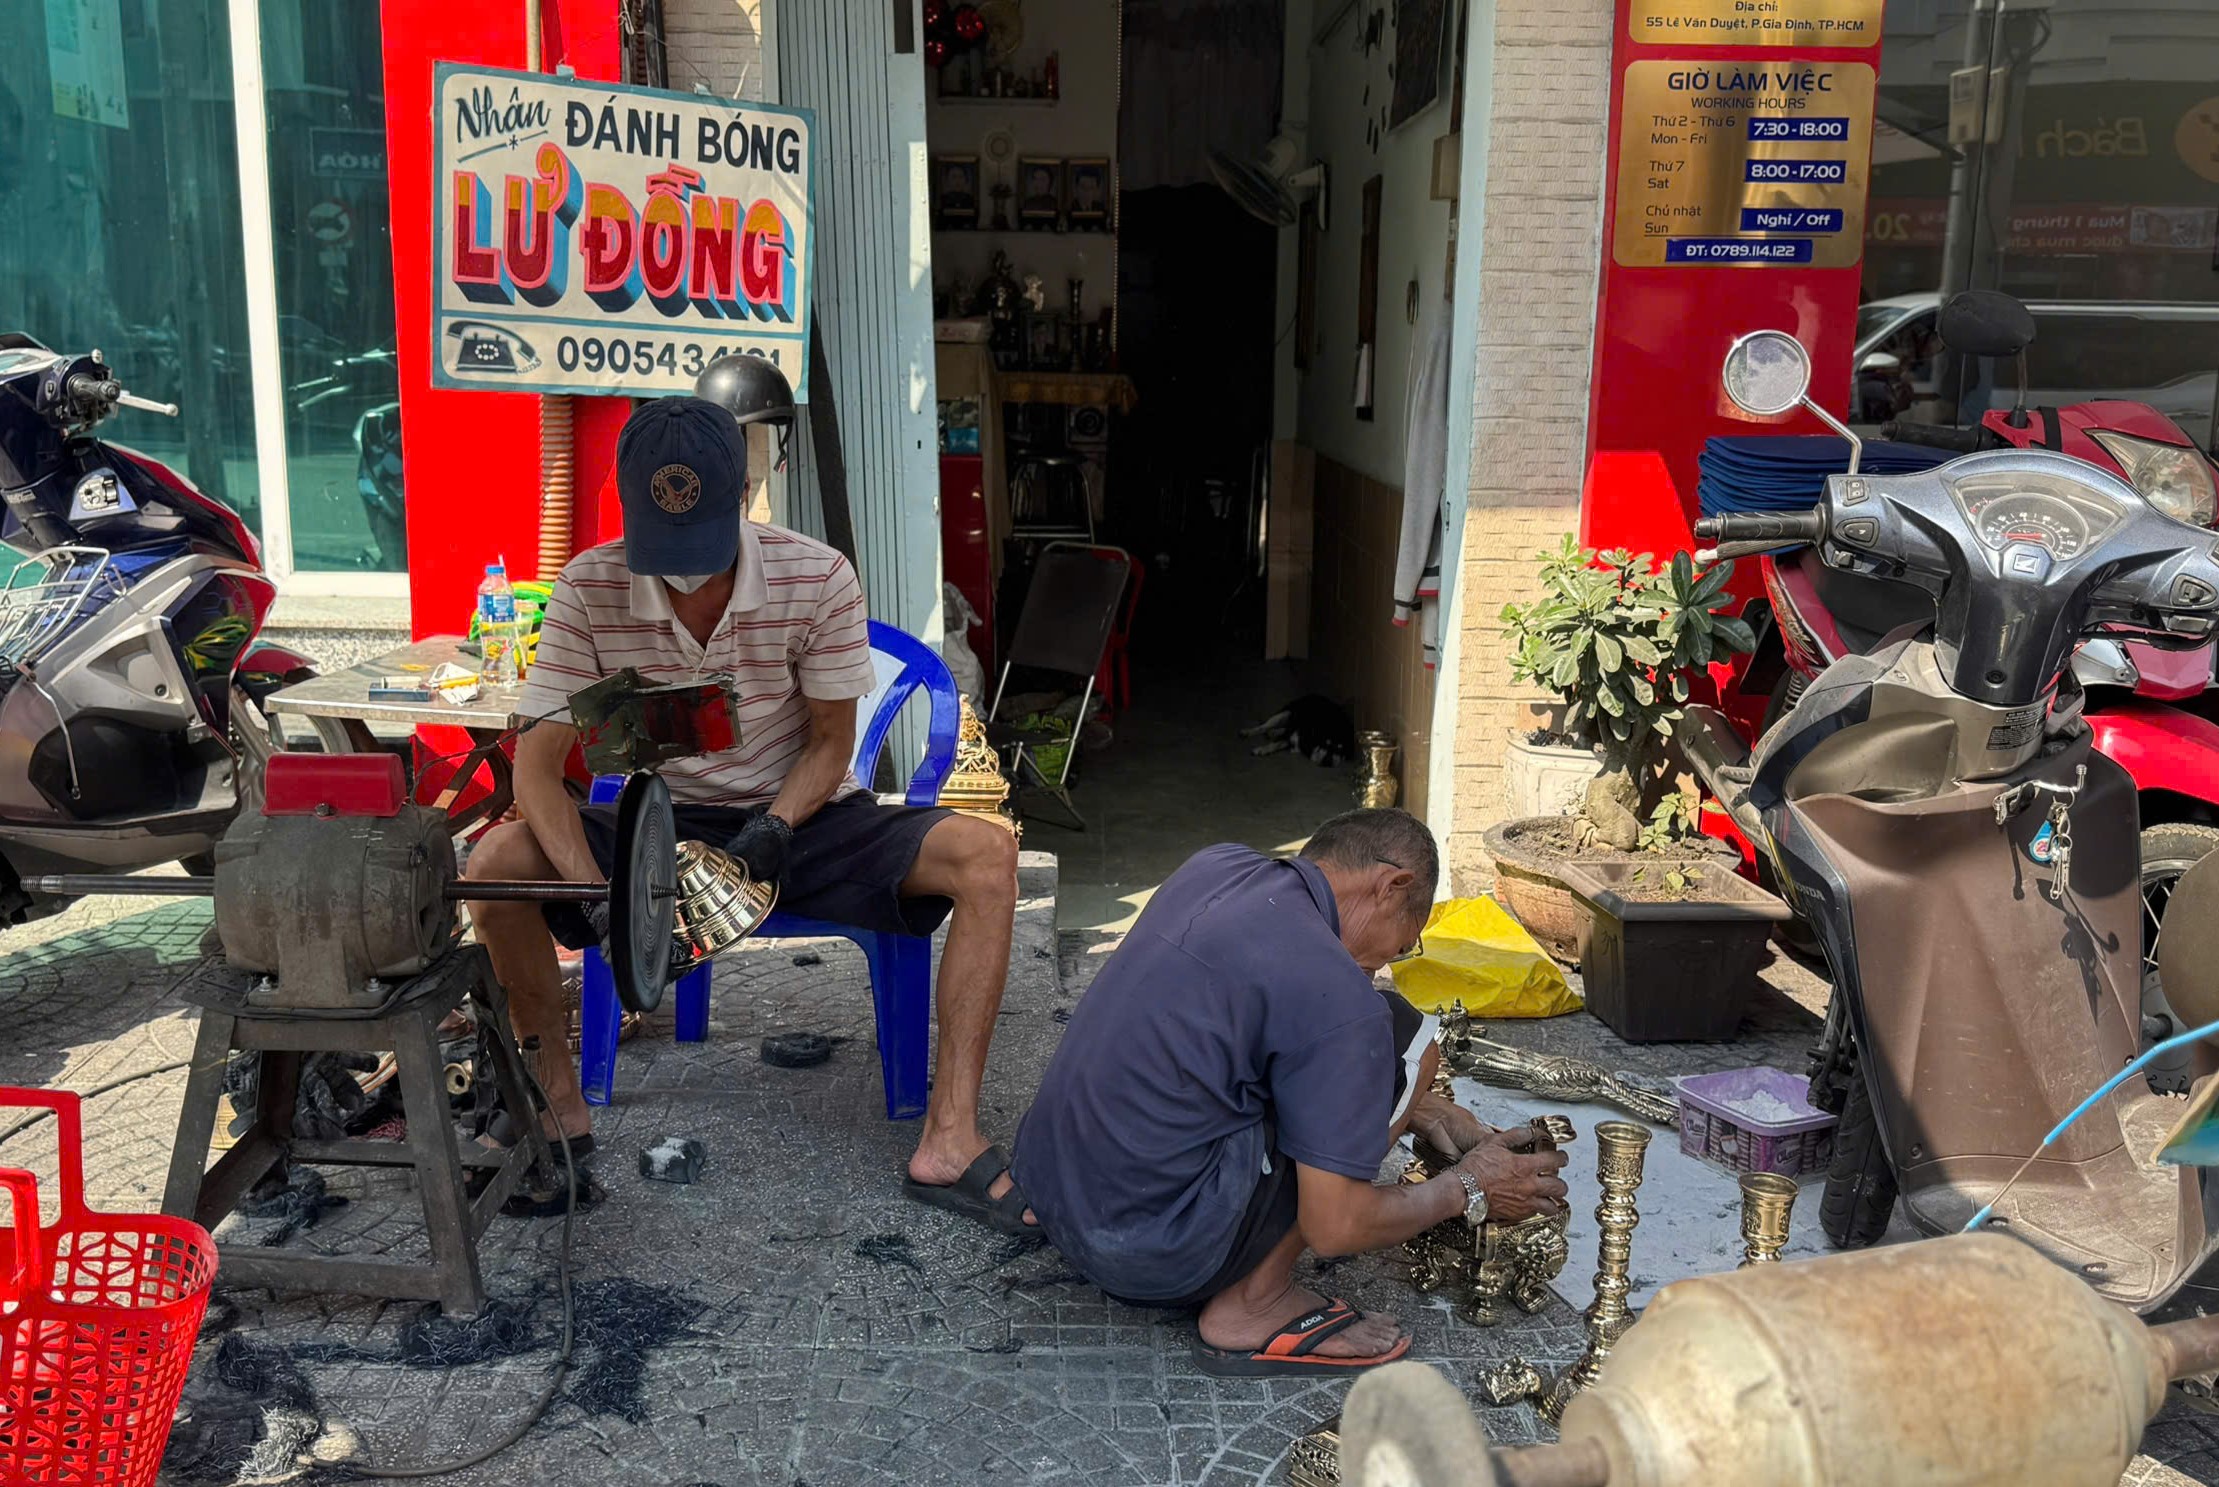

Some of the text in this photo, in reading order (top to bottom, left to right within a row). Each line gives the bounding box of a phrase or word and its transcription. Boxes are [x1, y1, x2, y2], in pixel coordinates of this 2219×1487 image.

[1735, 1, 1755, 13] Địa
[1646, 17, 1663, 27] 55
[1666, 17, 1679, 27] Lê
[1710, 18, 1748, 31] Duyệt,
[1751, 18, 1782, 29] P.Gia
[1785, 19, 1815, 31] Định,
[1819, 20, 1864, 31] TP.HCM
[1668, 67, 1832, 95] GIỜ LÀM VIỆC
[1691, 97, 1806, 109] WORKING HOURS
[1652, 115, 1677, 127] Thứ
[1679, 115, 1688, 126] 2
[1726, 115, 1736, 126] 6
[565, 95, 680, 160] ĐÁNH
[697, 112, 800, 175] BÓNG
[1753, 122, 1789, 136] 7:30
[1800, 122, 1841, 136] 18:00
[1651, 134, 1678, 144] Mon
[1690, 134, 1707, 144] Fri
[1649, 160, 1685, 172] Thứ 7
[1751, 164, 1789, 178] 8:00
[1800, 165, 1841, 178] 17:00
[1648, 178, 1669, 189] Sat
[1673, 206, 1701, 218] nhật
[1806, 214, 1831, 226] Off
[453, 142, 790, 312] LƯ ĐỒNG
[1645, 223, 1668, 233] Sun
[1686, 245, 1795, 257] ĐT: 0789.114.122
[1300, 1314, 1324, 1330] ADDA
